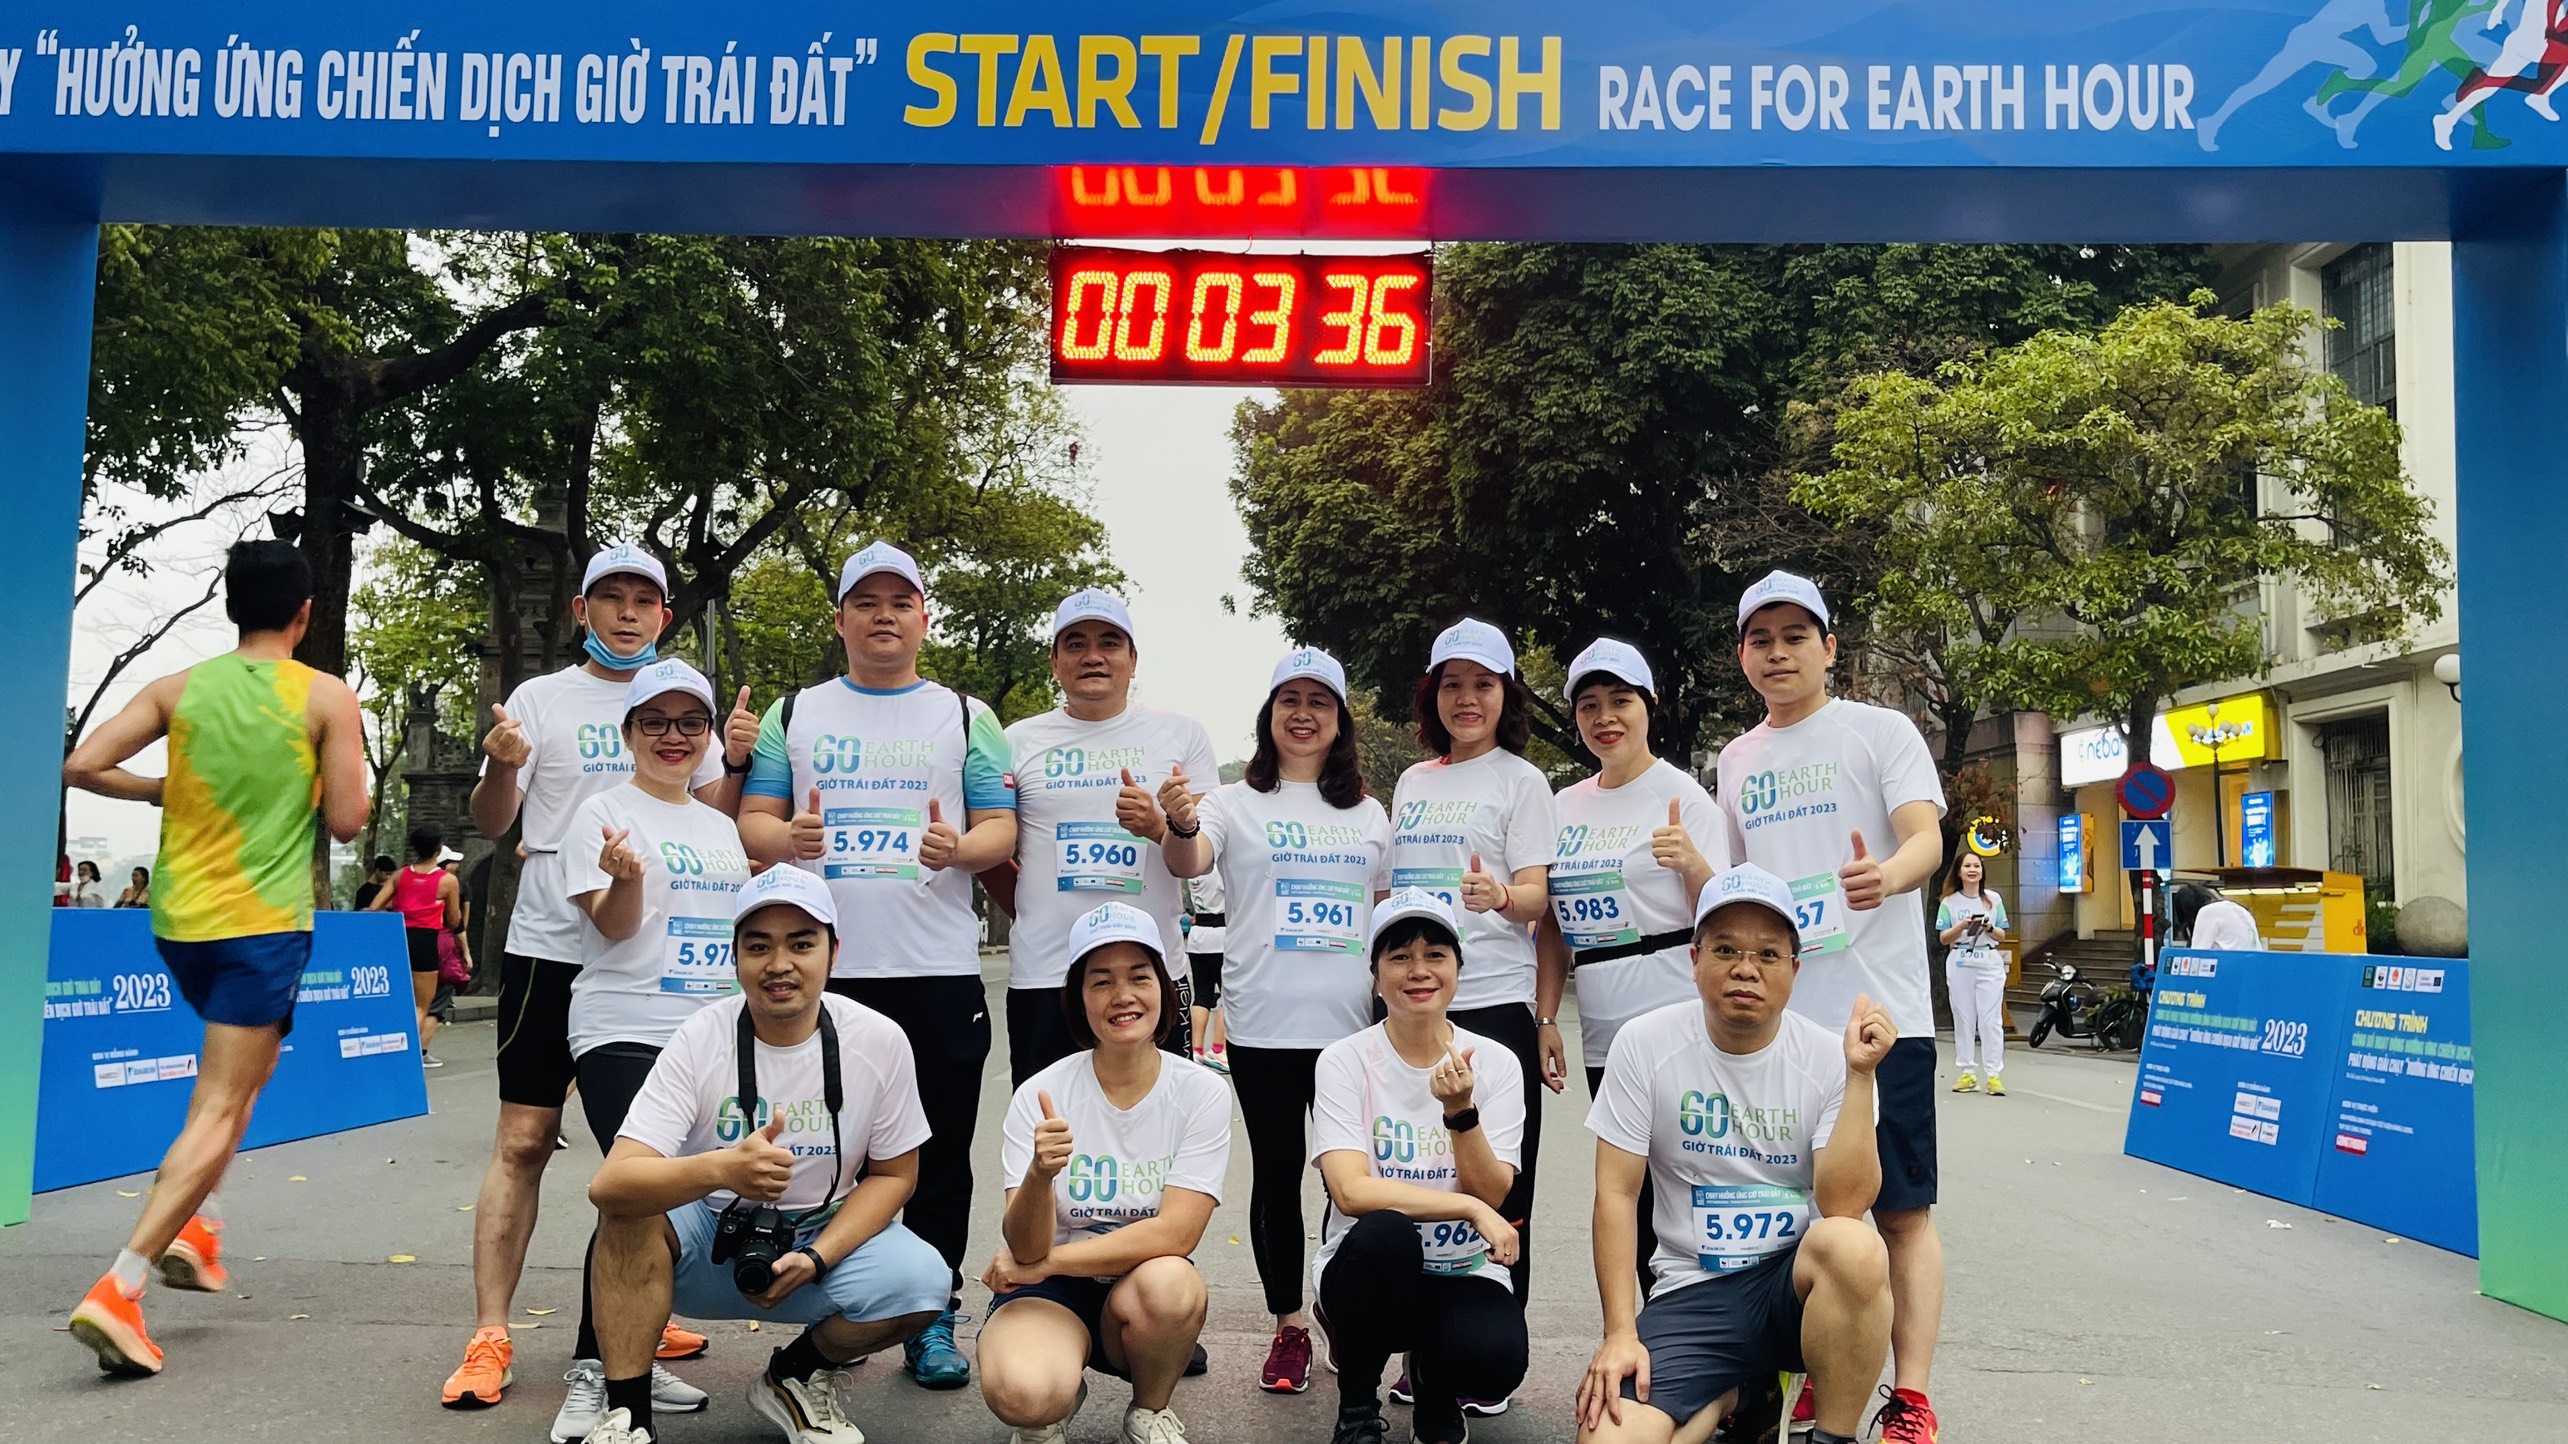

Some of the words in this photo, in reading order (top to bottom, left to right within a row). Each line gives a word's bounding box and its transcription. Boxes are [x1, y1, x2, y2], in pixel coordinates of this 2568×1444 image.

[37, 24, 201, 117] “HƯỞNG
[214, 34, 303, 119] ỨNG
[316, 29, 447, 121] CHIẾN
[459, 52, 562, 138] DỊCH
[575, 37, 650, 124] GIỜ
[661, 40, 757, 125] TRÁI
[769, 31, 878, 126] ĐẤT”
[903, 32, 1562, 145] START/FINISH
[1598, 64, 1732, 132] RACE
[1750, 64, 1850, 132] FOR
[1868, 64, 2026, 132] EARTH
[2044, 64, 2196, 132] HOUR
[1060, 270, 1172, 361] 00
[1185, 271, 1297, 363] 03
[1313, 273, 1420, 365] 36
[577, 723, 620, 759] 60
[865, 739, 935, 754] EARTH
[813, 734, 861, 774] 60
[864, 753, 929, 769] HOUR
[1044, 747, 1084, 778] 60
[1088, 746, 1145, 761] EARTH
[1088, 757, 1143, 772] HOUR
[583, 762, 604, 773] GIỜ
[605, 762, 629, 772] TRÁI
[1778, 762, 1838, 785] EARTH
[816, 777, 838, 790] GIỜ
[840, 778, 869, 790] TRÁI
[872, 777, 896, 790] ĐẤT
[899, 780, 928, 790] 2023
[1045, 779, 1066, 790] GIỜ
[1069, 778, 1093, 788] TRÁI
[1096, 776, 1118, 787] ĐẤT
[1741, 769, 1776, 815] 60
[1779, 777, 1833, 800] HOUR
[1421, 812, 1468, 826] HOUR
[1428, 801, 1478, 814] EARTH
[1745, 816, 1762, 830] GIỜ
[1763, 811, 1786, 824] TRÁI
[1788, 806, 1808, 819] ĐẤT
[1810, 802, 1837, 815] 2023
[833, 830, 909, 853] 5.974
[1266, 820, 1307, 849] 60
[1307, 825, 1363, 838] EARTH
[1310, 835, 1363, 847] HOUR
[1402, 834, 1421, 844] TRÁI
[1423, 834, 1441, 844] ĐẤT
[1442, 834, 1464, 845] 2023
[1588, 825, 1639, 840] EARTH
[1066, 843, 1137, 867] 5.960
[1582, 838, 1629, 852] HOUR
[660, 841, 703, 876] 60
[1272, 851, 1292, 862] GIỜ
[1293, 853, 1318, 863] TRÁI
[1320, 852, 1341, 864] ĐẤT
[1343, 855, 1367, 866] 2023
[1560, 860, 1580, 871] TRÁI
[1582, 859, 1599, 870] ĐẤT
[1600, 859, 1624, 869] 2023
[671, 880, 690, 890] GIỜ
[692, 880, 711, 890] TRÁI
[712, 880, 730, 892] ĐẤT
[1721, 874, 1741, 892] 60
[1089, 904, 1109, 928] 60
[1287, 902, 1352, 927] 5.961
[1557, 896, 1620, 922] 5.983
[113, 972, 171, 1010] 2023
[350, 966, 390, 995] 2023
[2355, 1009, 2397, 1031] CHƯƠNG
[2398, 1009, 2429, 1034] TRÌNH
[2261, 1018, 2308, 1056] 2023
[1680, 1090, 1729, 1139] 60
[1730, 1103, 1797, 1125] EARTH
[1373, 1115, 1415, 1163] 60
[1732, 1119, 1793, 1141] HOUR
[1682, 1140, 1706, 1153] GIỜ
[1707, 1144, 1737, 1157] TRÁI
[1739, 1147, 1762, 1162] ĐẤT
[1765, 1154, 1798, 1165] 2023
[1069, 1153, 1117, 1202] 60
[1396, 1167, 1425, 1180] TRÁI
[1427, 1166, 1448, 1180] ĐẤT
[1070, 1206, 1094, 1218] GIỜ
[1096, 1206, 1127, 1217] TRÁI
[1129, 1206, 1156, 1217] ĐẤT
[1706, 1211, 1796, 1240] 5.972
